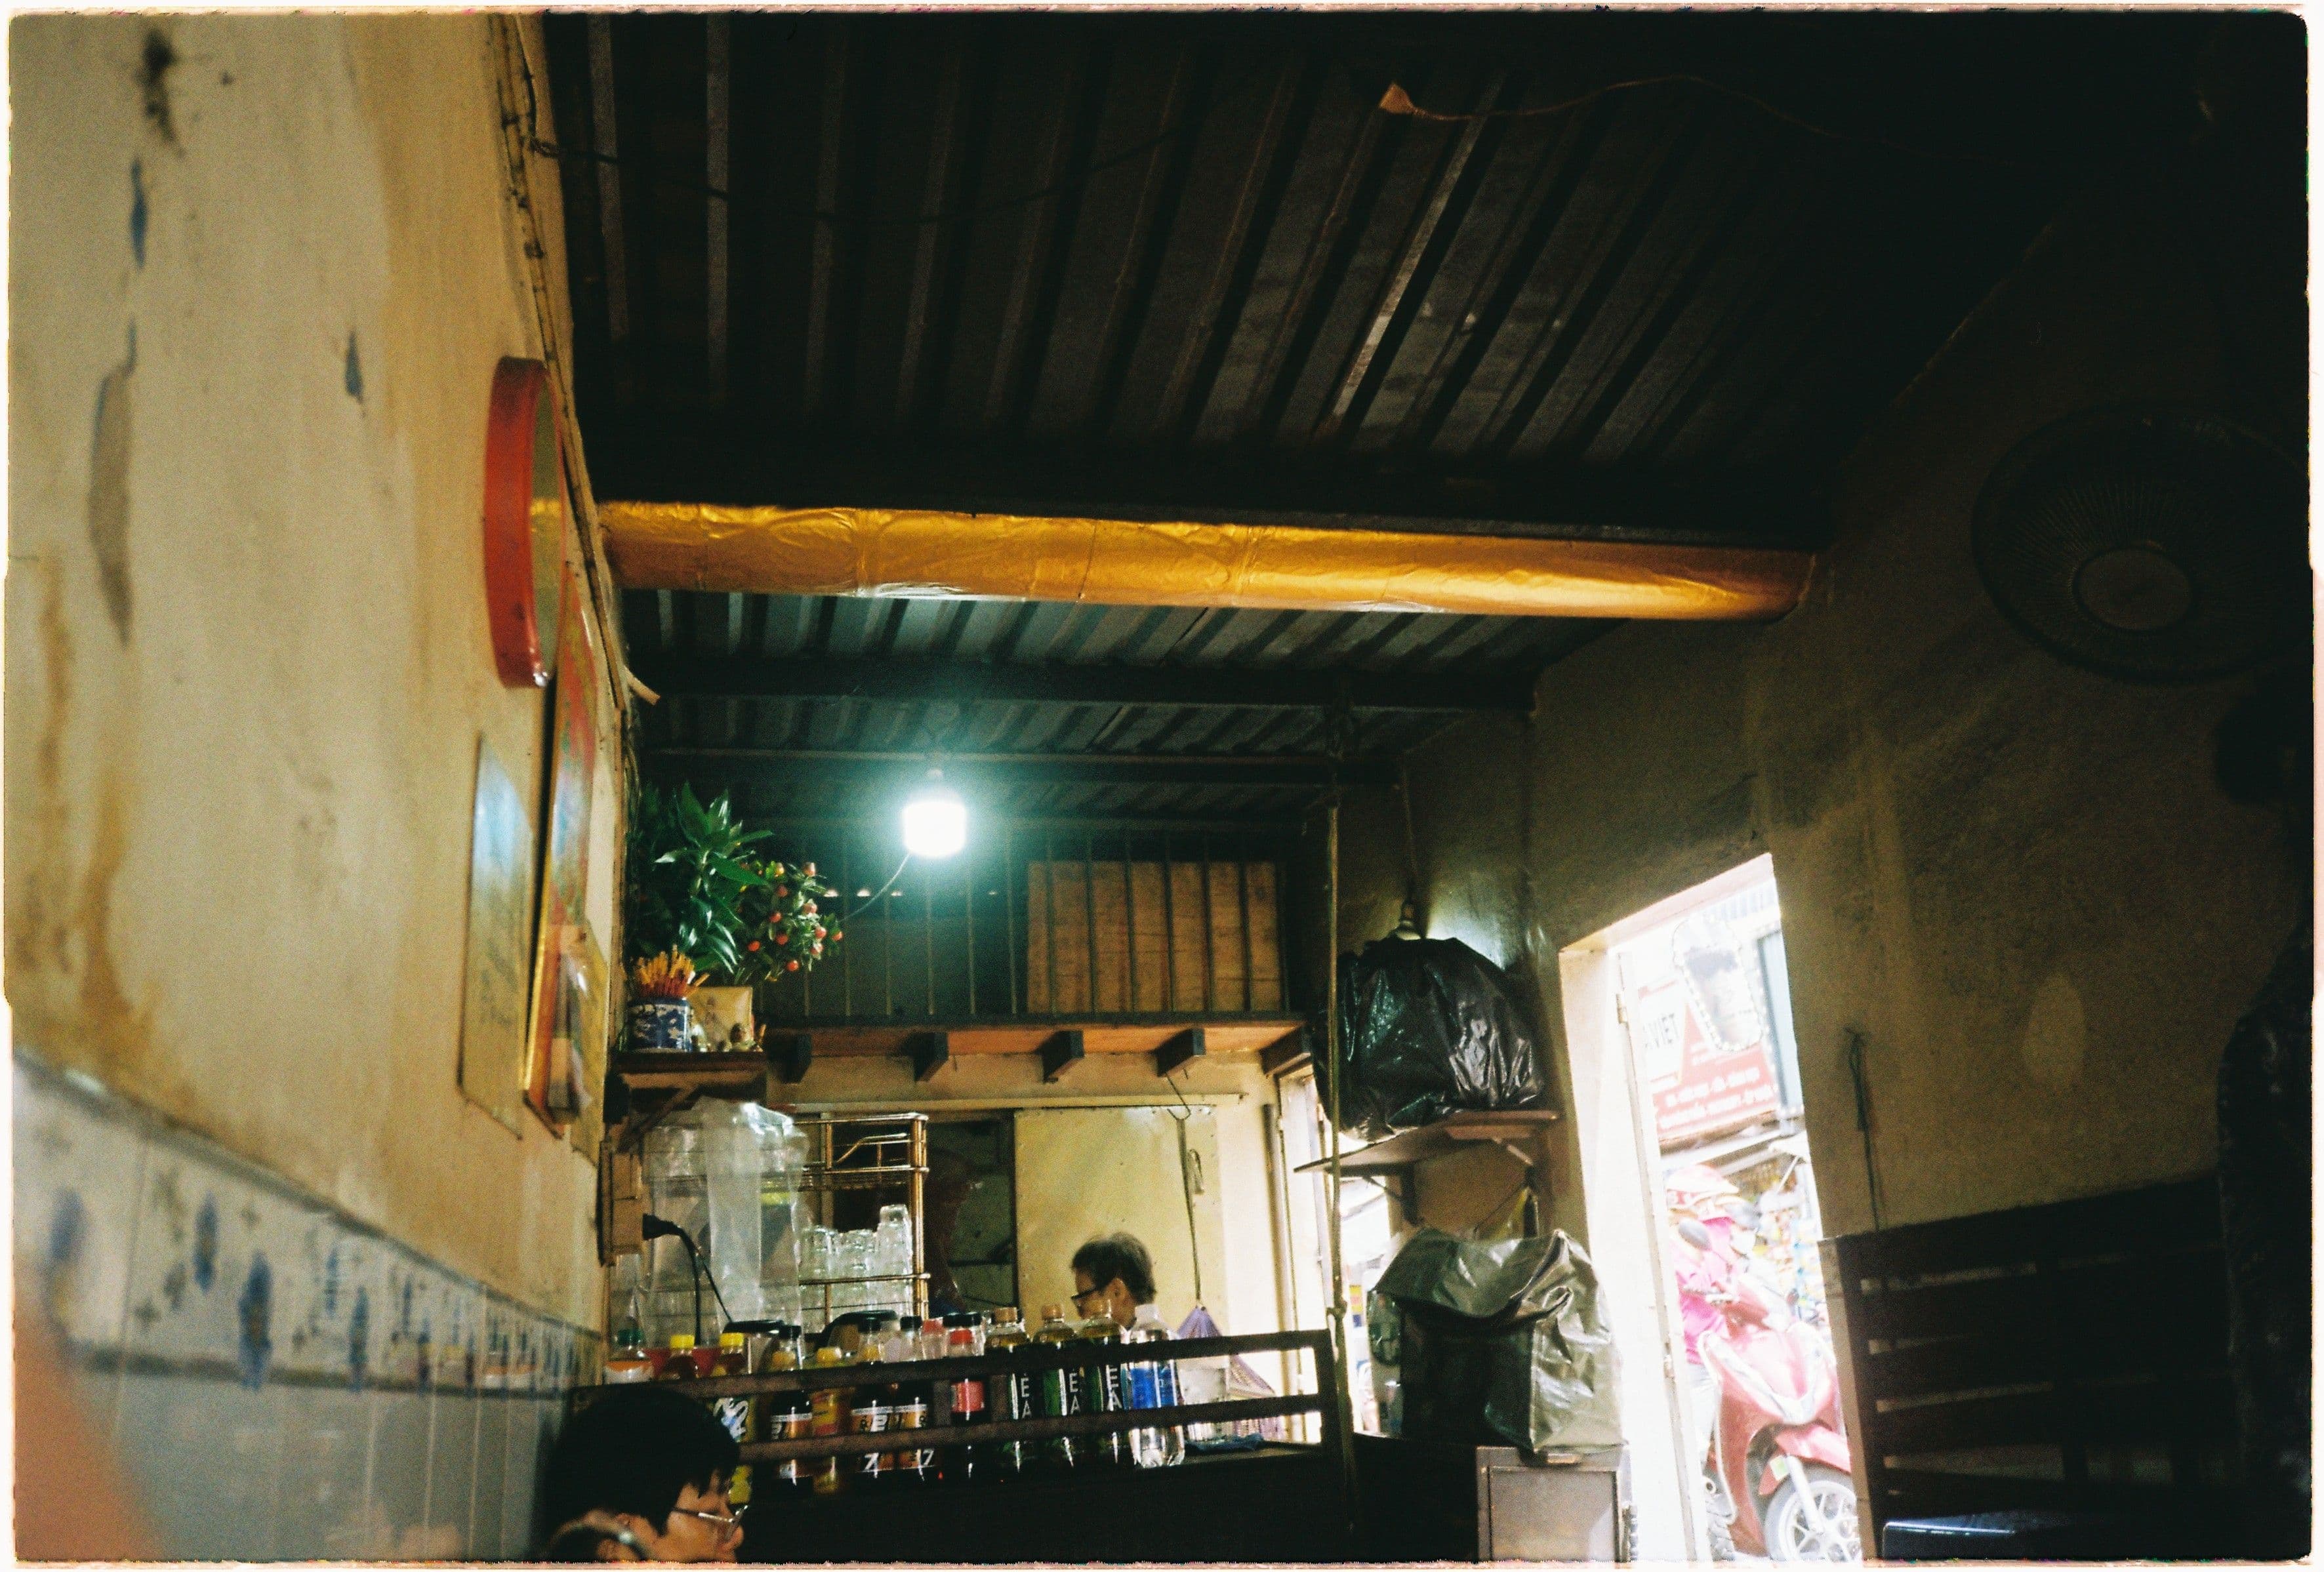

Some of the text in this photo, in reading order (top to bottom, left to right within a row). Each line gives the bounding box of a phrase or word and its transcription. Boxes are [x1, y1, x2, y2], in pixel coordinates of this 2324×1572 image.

[1021, 1373, 1032, 1419] EA
[1069, 1369, 1081, 1415] EA
[1107, 1365, 1122, 1411] EA
